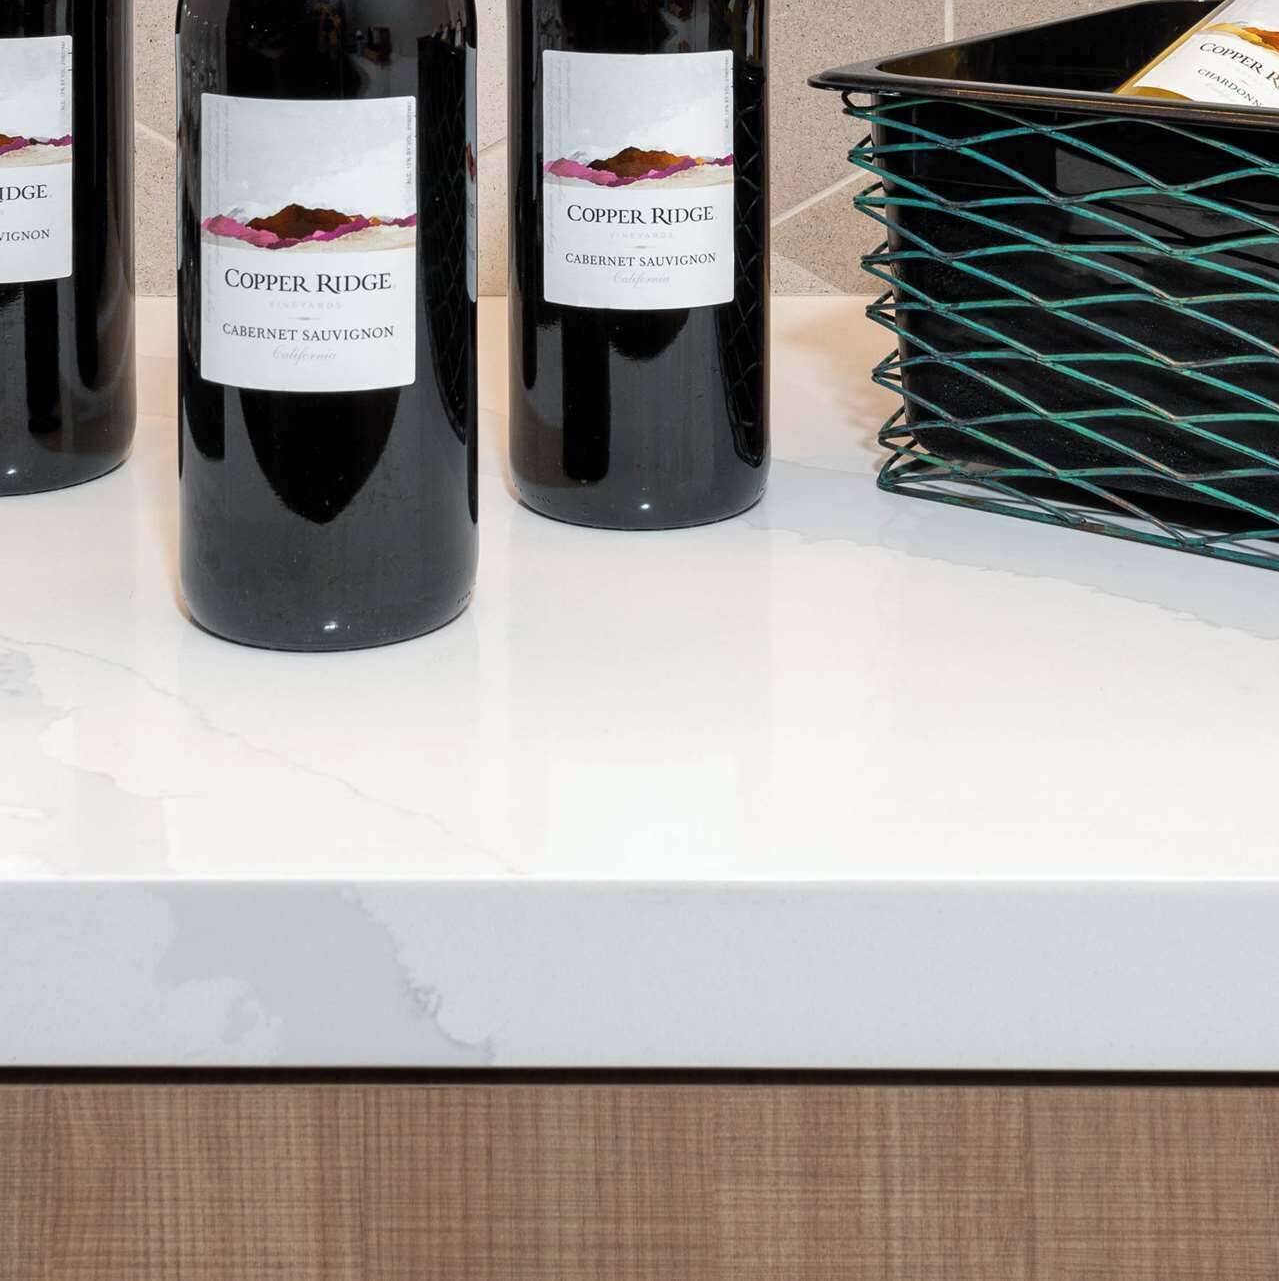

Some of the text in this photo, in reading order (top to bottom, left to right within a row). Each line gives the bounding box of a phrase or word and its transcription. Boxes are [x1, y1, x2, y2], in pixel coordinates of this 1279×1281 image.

[1199, 42, 1264, 75] COPPER
[1197, 68, 1263, 107] CHARDONN
[566, 204, 714, 226] COPPER RIDGE
[565, 251, 716, 267] CABERNET SAUVIGNON
[224, 268, 392, 295] COPPER RIDGE
[222, 322, 395, 342] CABERNET SAUVIGNON
